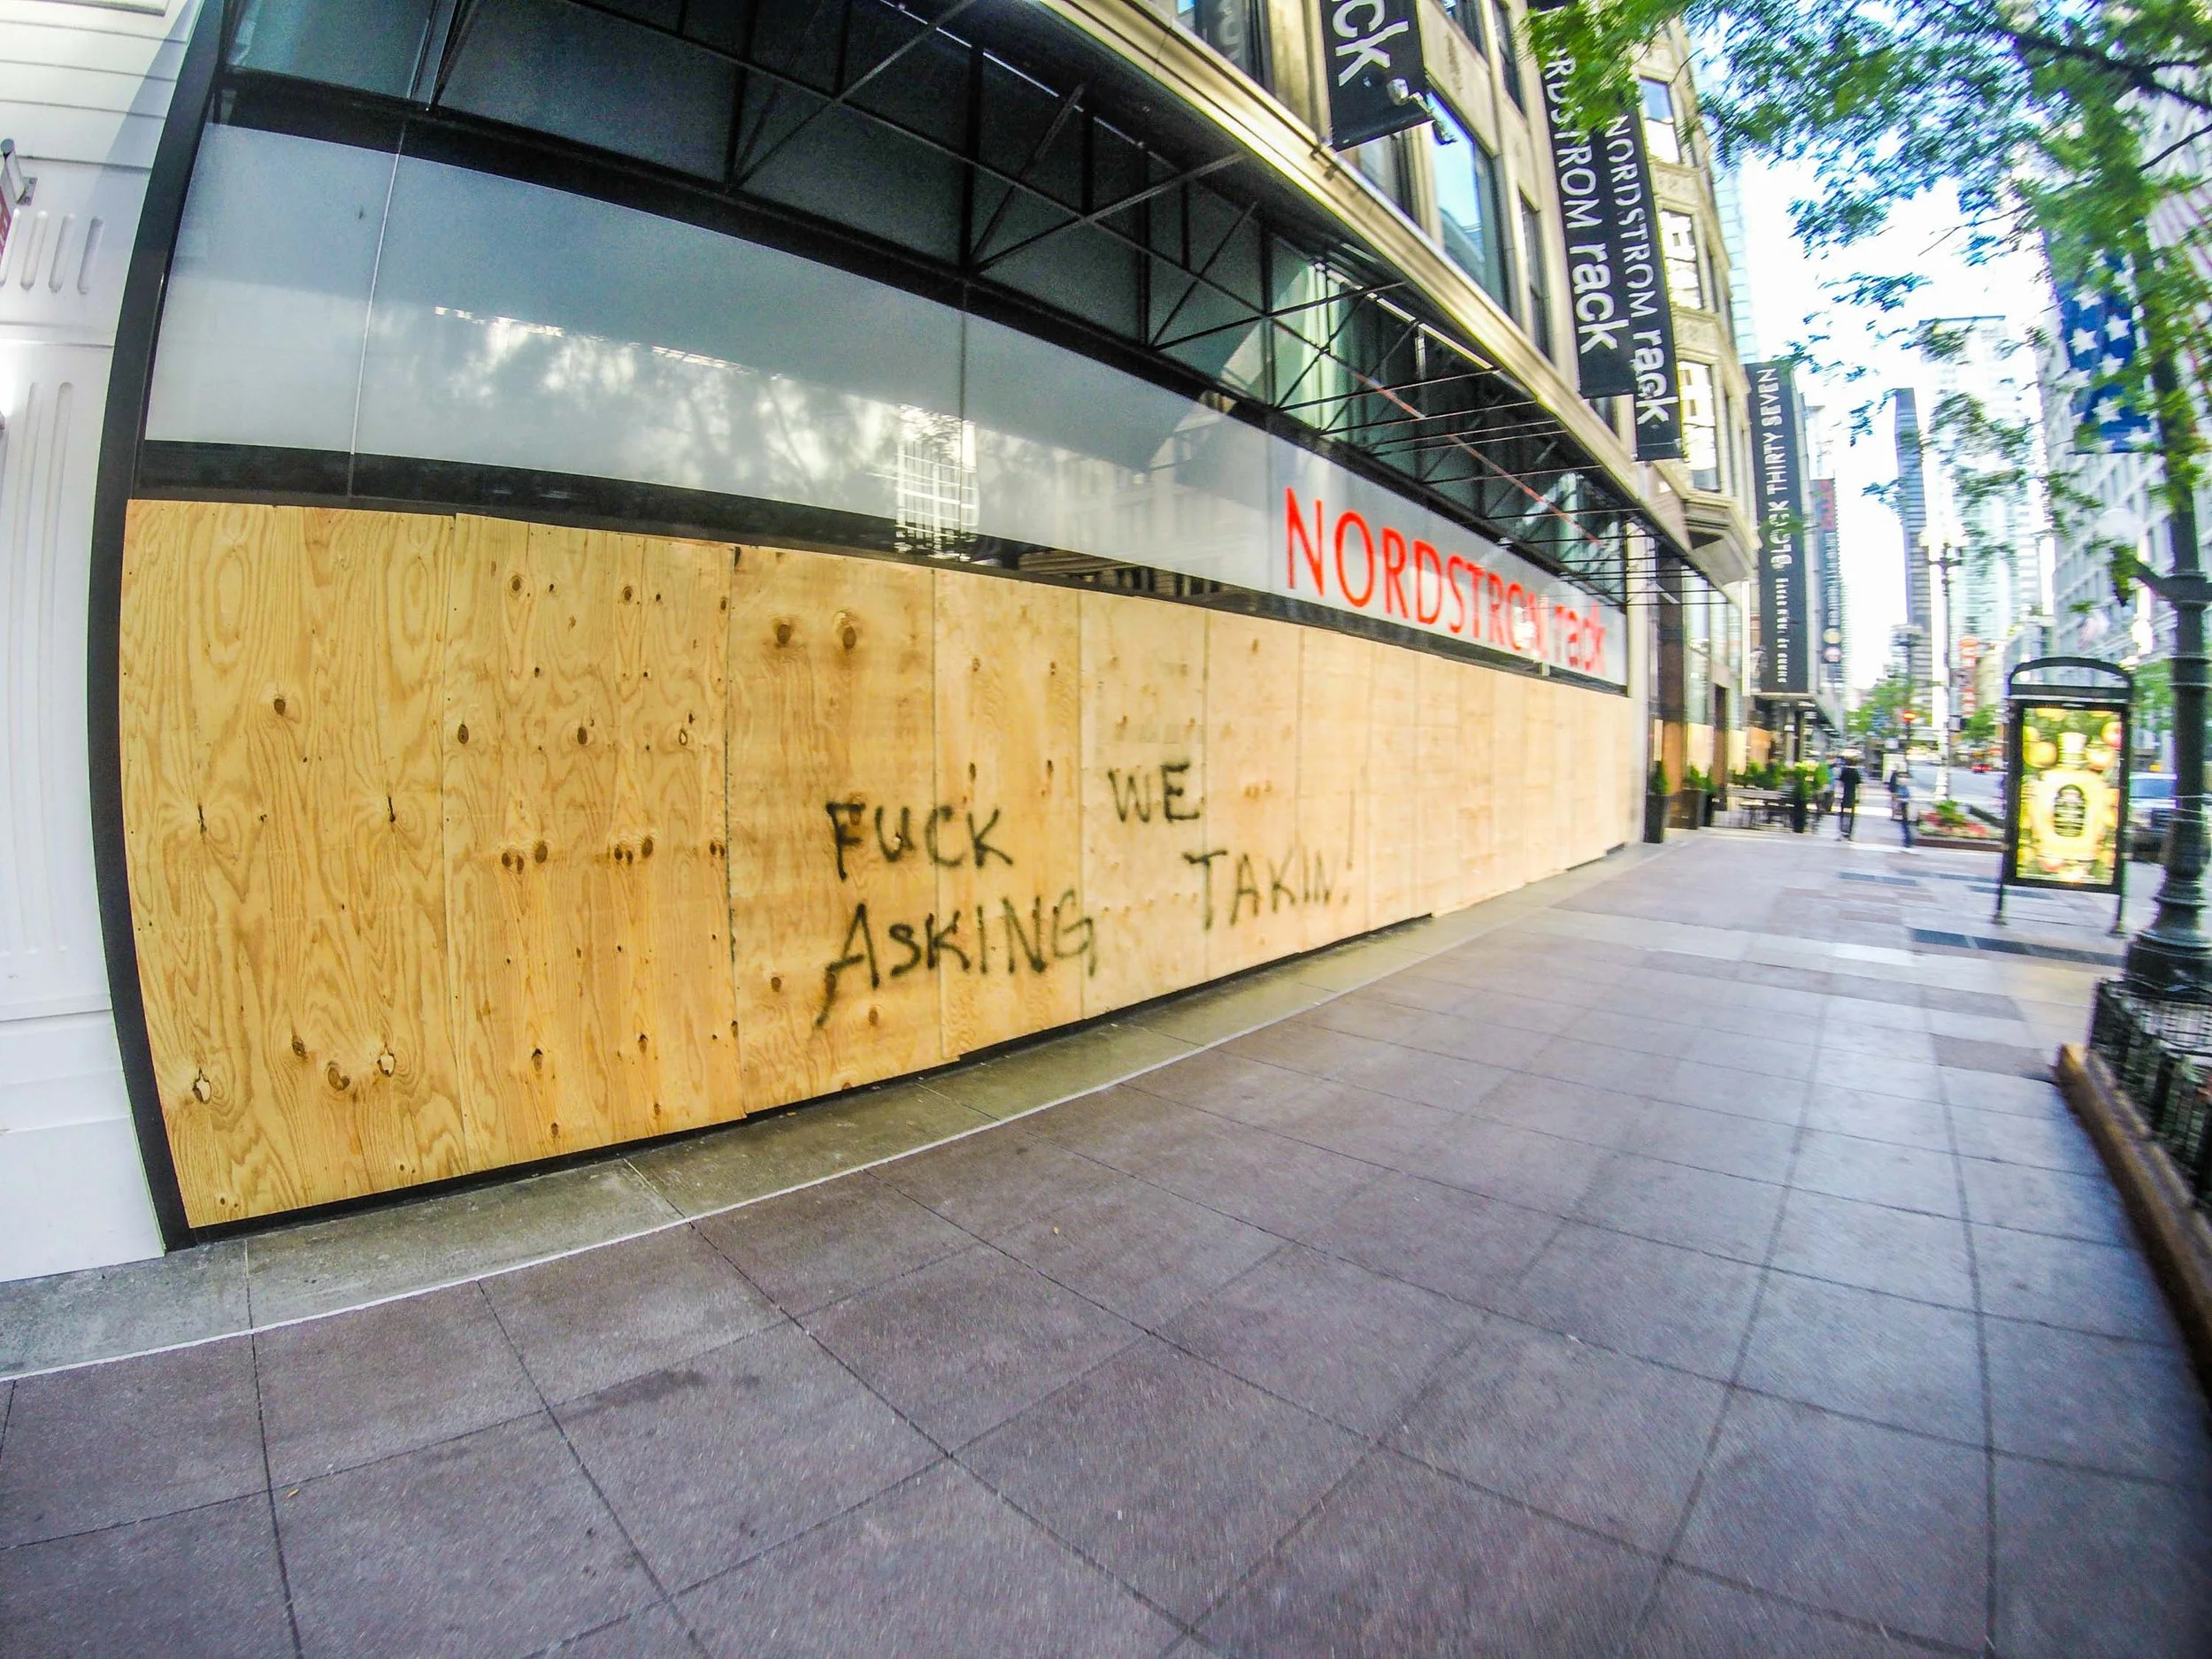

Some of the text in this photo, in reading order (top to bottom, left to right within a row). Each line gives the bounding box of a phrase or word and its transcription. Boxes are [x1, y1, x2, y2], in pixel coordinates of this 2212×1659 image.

[1332, 0, 1409, 87] ck
[1569, 244, 1630, 355] rack
[1604, 113, 1679, 426] NORDSTROM rack
[1756, 367, 1782, 427] SEVEN
[1762, 432, 1788, 497] THIRTY
[1107, 760, 1201, 824] WE
[826, 801, 1013, 881] FUCK
